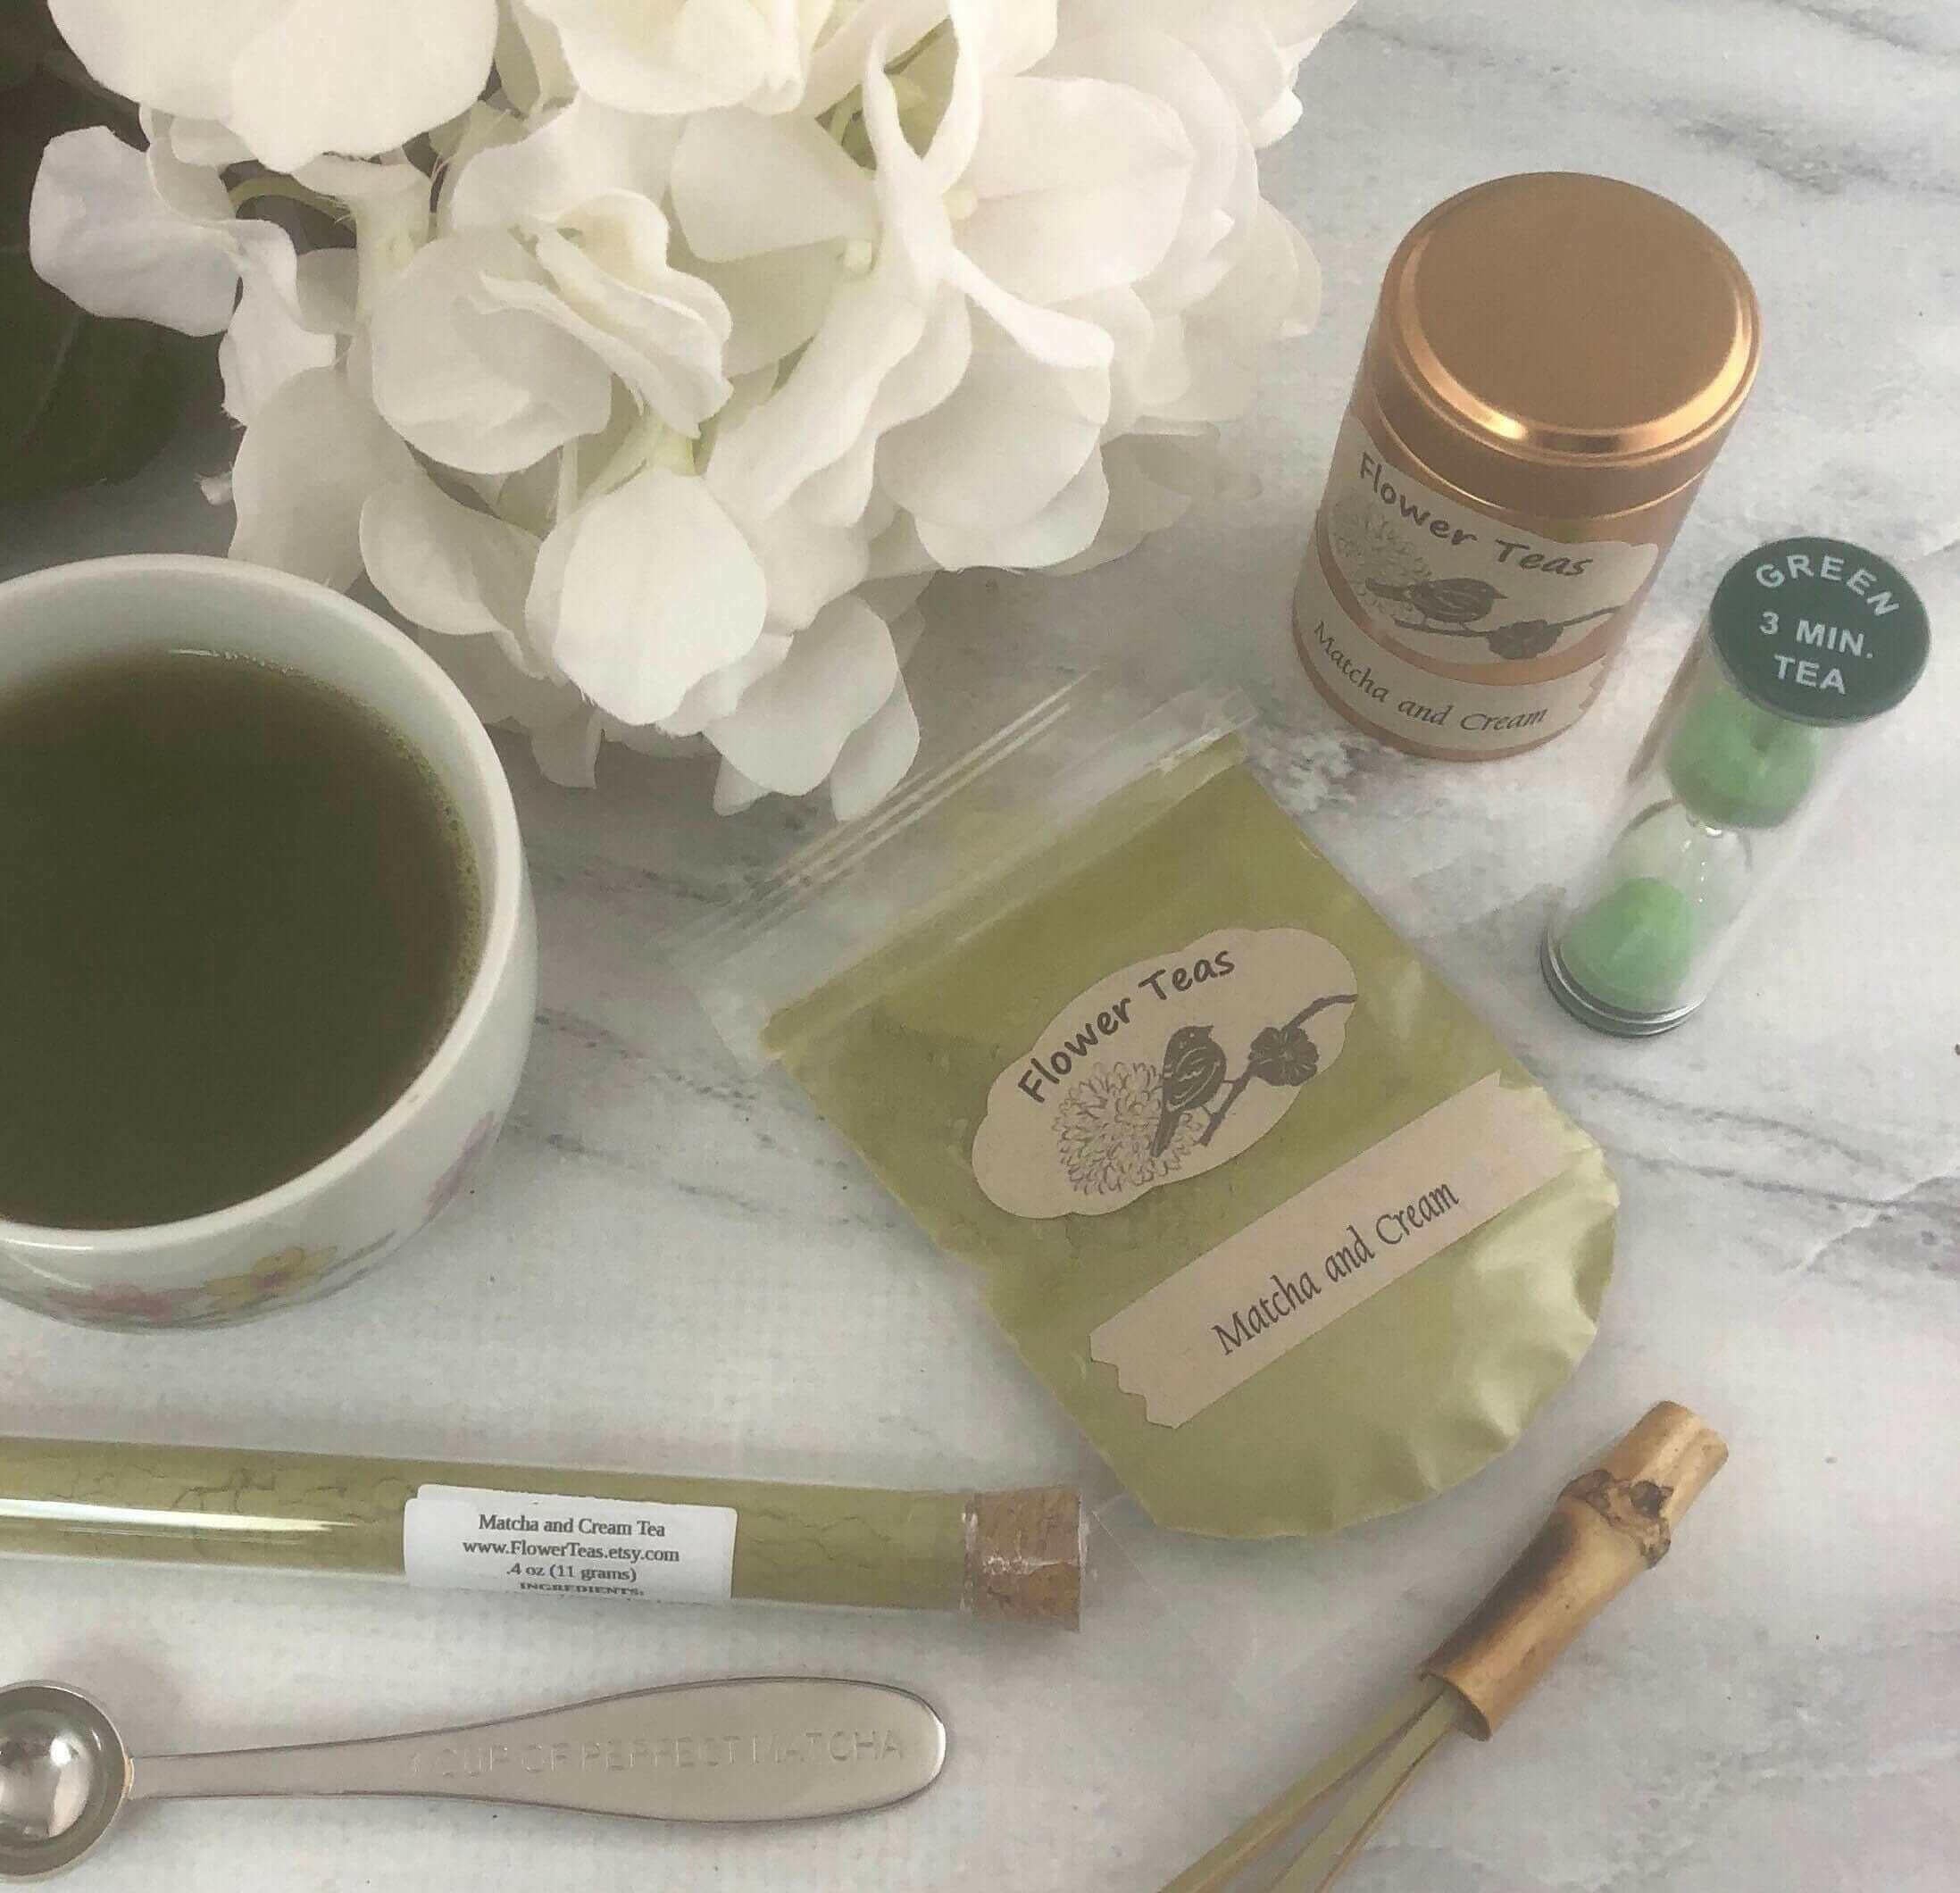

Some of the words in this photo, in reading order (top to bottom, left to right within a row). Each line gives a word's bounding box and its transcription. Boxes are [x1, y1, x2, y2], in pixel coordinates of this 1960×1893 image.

[1358, 451, 1478, 546] Flower
[1495, 538, 1593, 577] Teas
[1756, 554, 1900, 616] GREEN
[1759, 611, 1780, 635] 3
[1796, 619, 1873, 659] MIN.
[1314, 621, 1389, 703] Matcha
[1398, 699, 1455, 727] and
[1459, 708, 1547, 731] Cream
[1773, 654, 1847, 695] TEA
[1018, 997, 1131, 1104] Flower
[1138, 950, 1235, 1000] Teas
[1210, 1274, 1322, 1355] Matcha
[1324, 1224, 1375, 1282] and
[1375, 1183, 1459, 1246] Cream
[463, 1539, 680, 1563] www.FlowerTeas.etsy.com
[478, 1514, 539, 1532] Matcha
[543, 1518, 573, 1534] and
[578, 1518, 632, 1537] Cream
[637, 1521, 665, 1537] Tea
[525, 1566, 545, 1577] oz
[549, 1564, 575, 1580] (11
[580, 1567, 638, 1583] grams)
